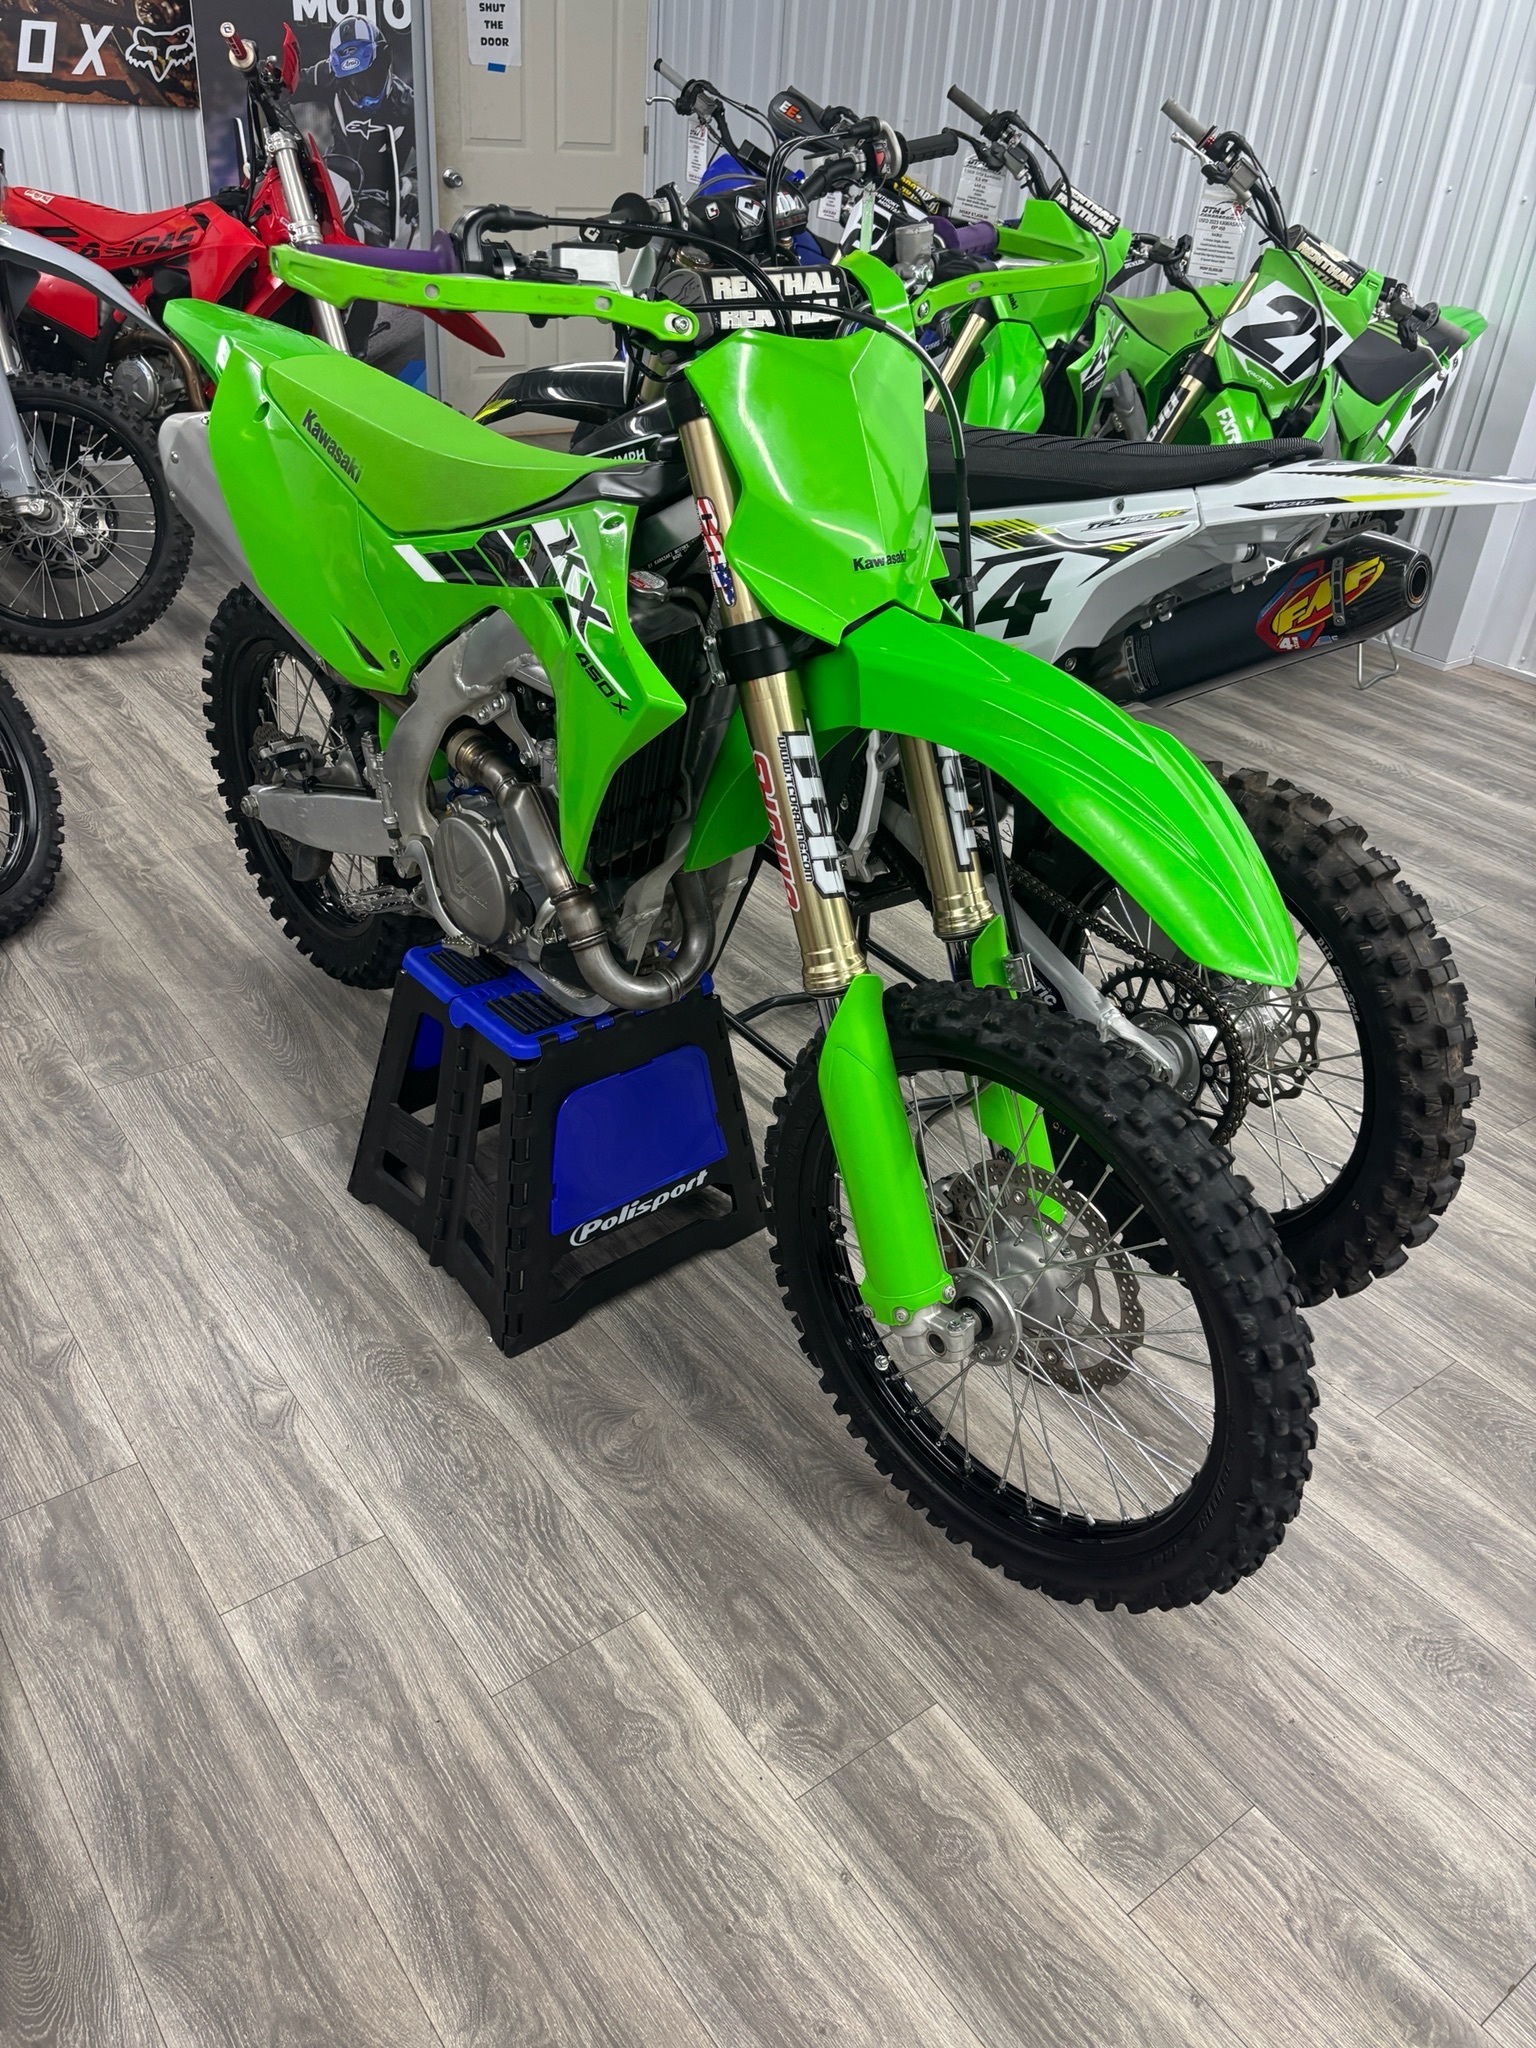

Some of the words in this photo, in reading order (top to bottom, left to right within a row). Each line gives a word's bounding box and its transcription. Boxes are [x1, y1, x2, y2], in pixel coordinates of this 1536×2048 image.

[292, 0, 412, 30] MOTO
[479, 3, 506, 13] SHUT
[484, 20, 504, 30] THE
[0, 18, 115, 77] OX
[480, 37, 510, 47] DOOR
[1054, 191, 1113, 235] RNTHAL
[1296, 240, 1356, 290] RENTHAL
[720, 298, 843, 330] RENHAL
[1231, 294, 1344, 382] 21
[1216, 406, 1243, 445] FXR
[302, 408, 364, 484] Kawasaki
[852, 549, 907, 572] Kawasaki
[1273, 556, 1385, 637] FMF
[1032, 977, 1058, 1006] TIC
[570, 1168, 709, 1247] Polisport
